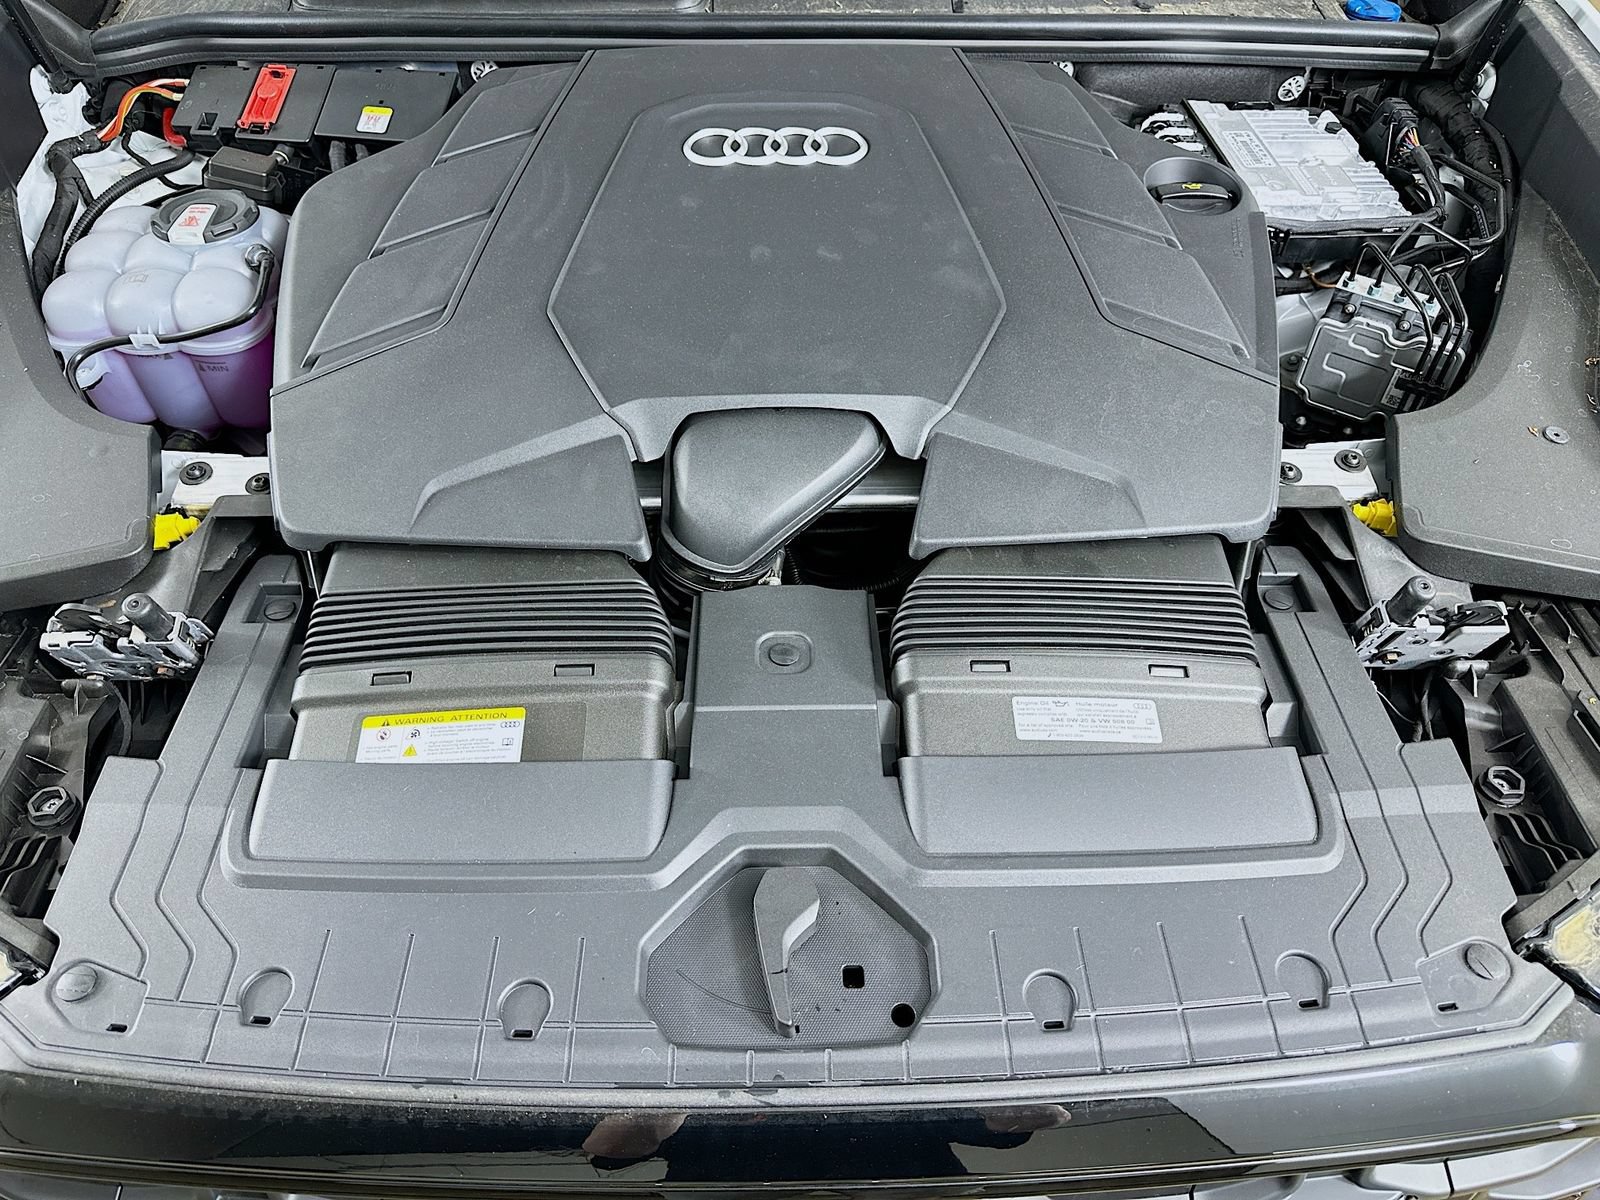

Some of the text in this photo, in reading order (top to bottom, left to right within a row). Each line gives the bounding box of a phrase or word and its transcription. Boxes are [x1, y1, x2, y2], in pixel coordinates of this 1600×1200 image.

[206, 364, 229, 372] MIN
[394, 712, 508, 725] WARNING ATTENTION
